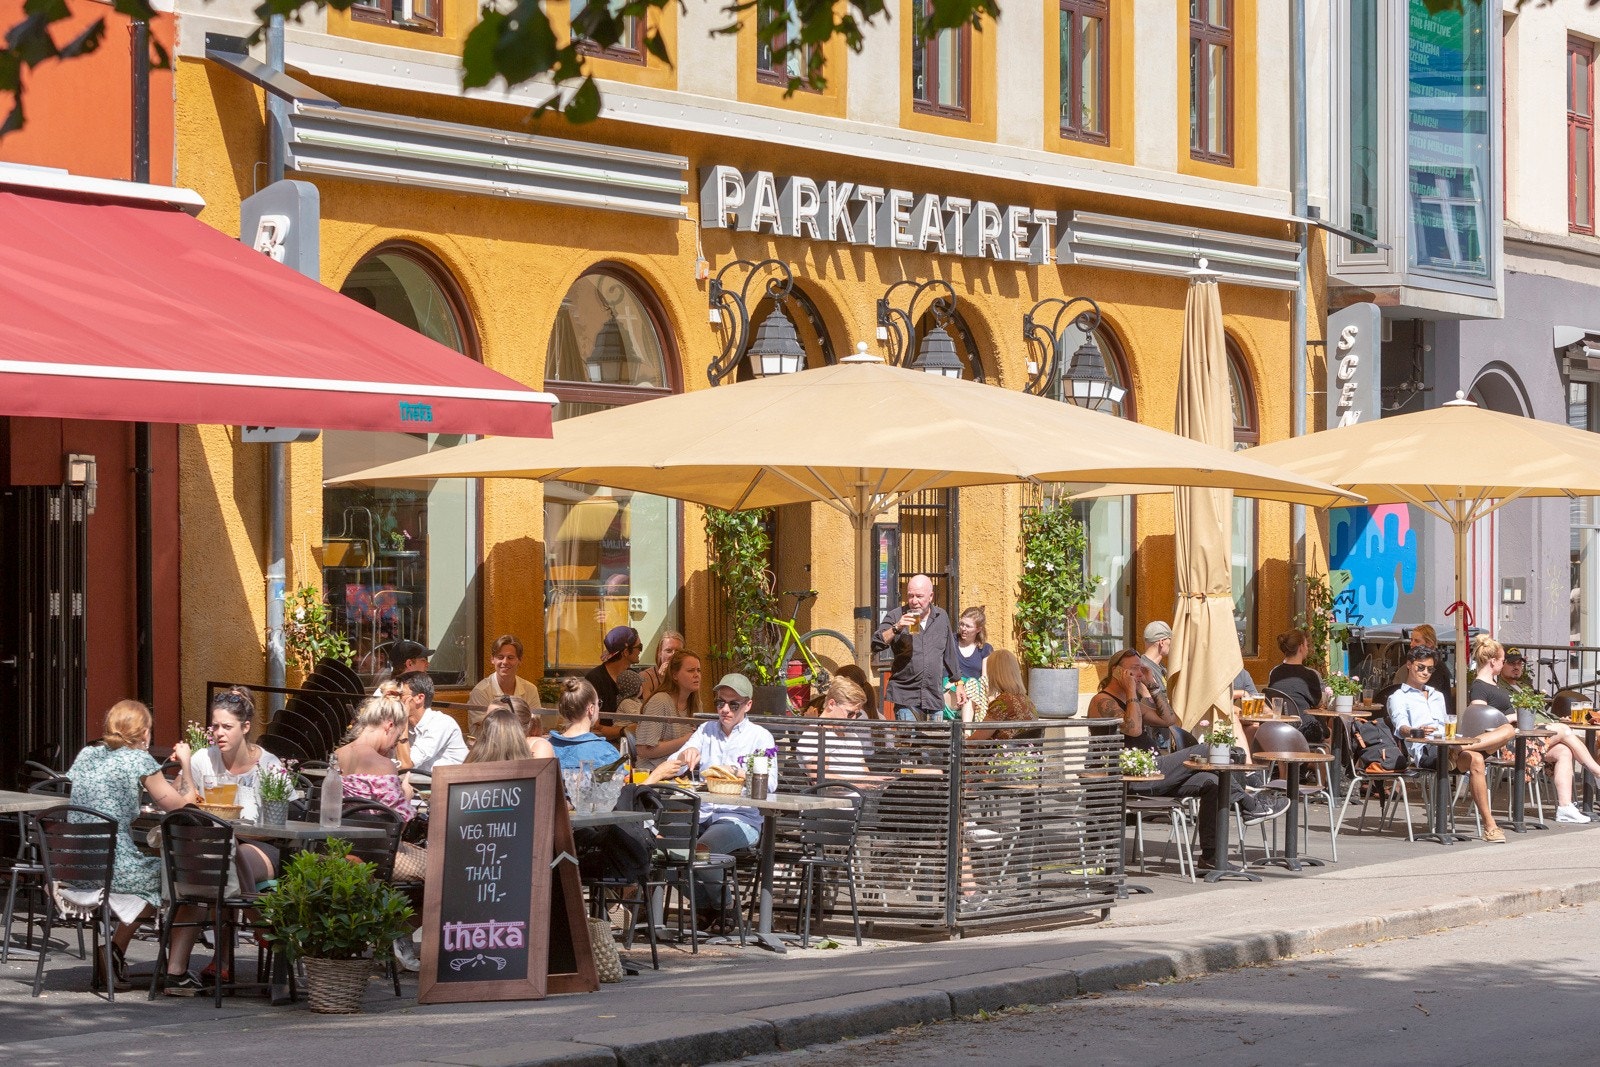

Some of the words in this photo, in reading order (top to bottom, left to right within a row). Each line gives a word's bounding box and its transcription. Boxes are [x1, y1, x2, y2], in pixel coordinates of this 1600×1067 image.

[702, 165, 1057, 265] PARKTEATRET
[460, 786, 522, 810] DAGENS
[459, 823, 484, 840] VEG.
[487, 822, 517, 838] THALI
[465, 865, 502, 882] THALI
[443, 918, 525, 952] theka
